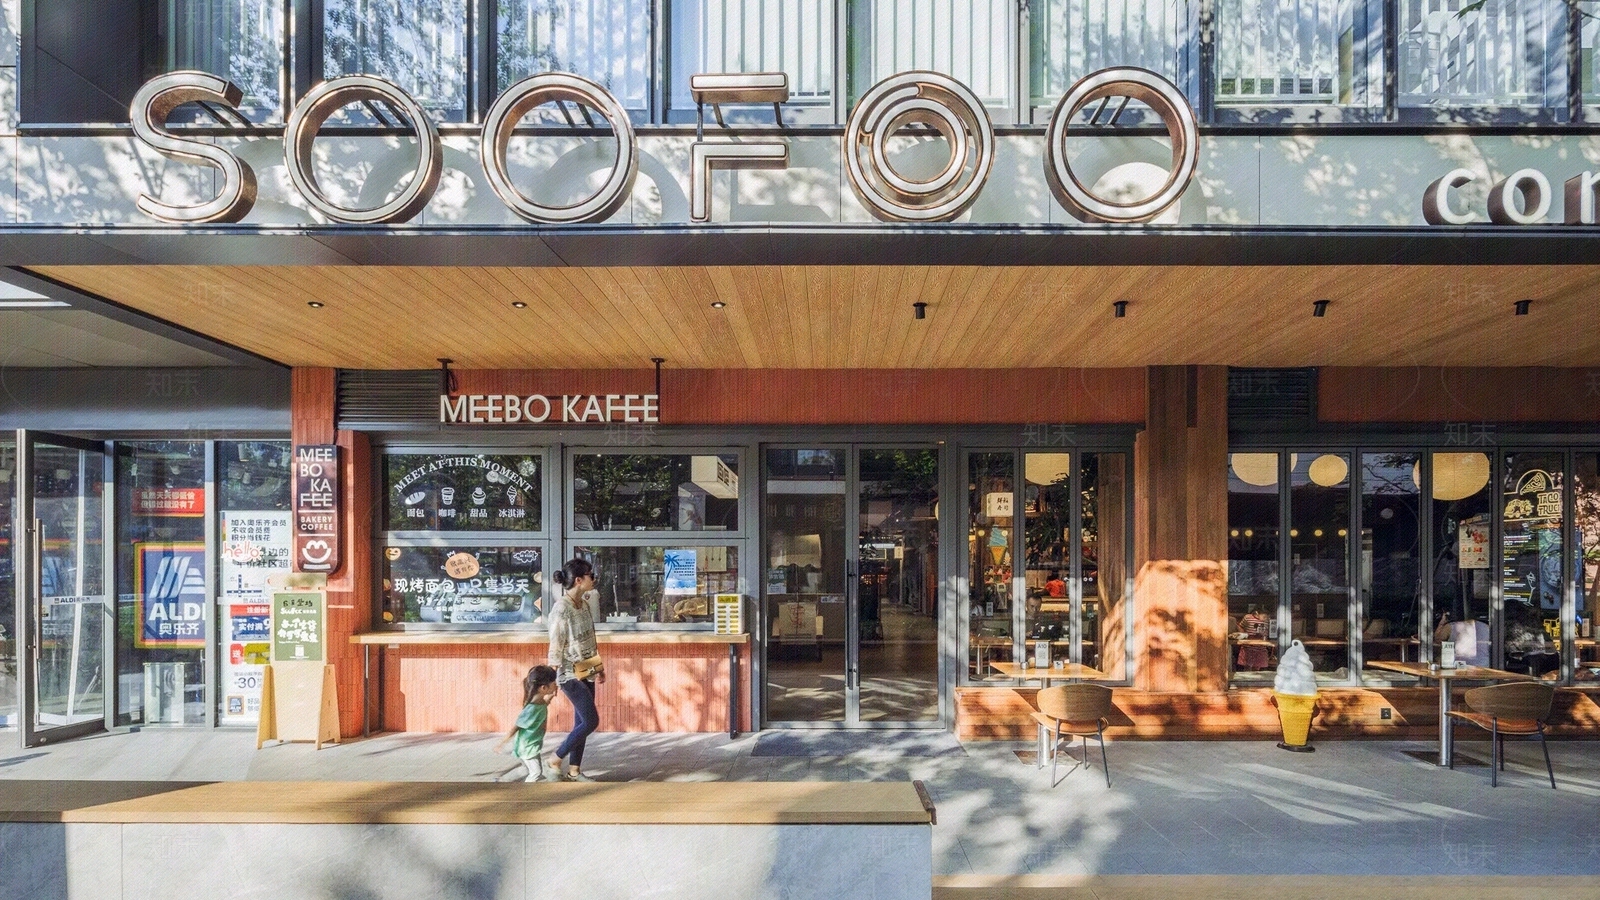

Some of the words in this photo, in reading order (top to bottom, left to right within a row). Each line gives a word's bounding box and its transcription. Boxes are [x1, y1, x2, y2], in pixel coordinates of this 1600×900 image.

[440, 394, 550, 423] MEEBO
[562, 394, 659, 423] KAFEE
[300, 448, 332, 462] MEE
[300, 463, 322, 477] BO
[394, 463, 427, 493] MEET
[428, 459, 446, 473] AT
[445, 456, 478, 467] THIS
[479, 458, 534, 493] MOMENT
[310, 478, 332, 492] KA
[300, 493, 332, 507] FEE
[1537, 492, 1560, 504] TACO
[406, 508, 425, 518] 面包
[438, 508, 457, 518] 咖啡
[469, 508, 488, 518] 甜品
[498, 508, 526, 518] 冰淇淋
[231, 519, 287, 527] 加入奥乐齐会员
[301, 523, 333, 531] COFFEE
[231, 534, 271, 542] 积分当钱花
[223, 541, 261, 559] hello
[394, 578, 456, 593] 现烤面包
[470, 578, 531, 594] 只售当天
[159, 622, 200, 636] 奥乐齐
